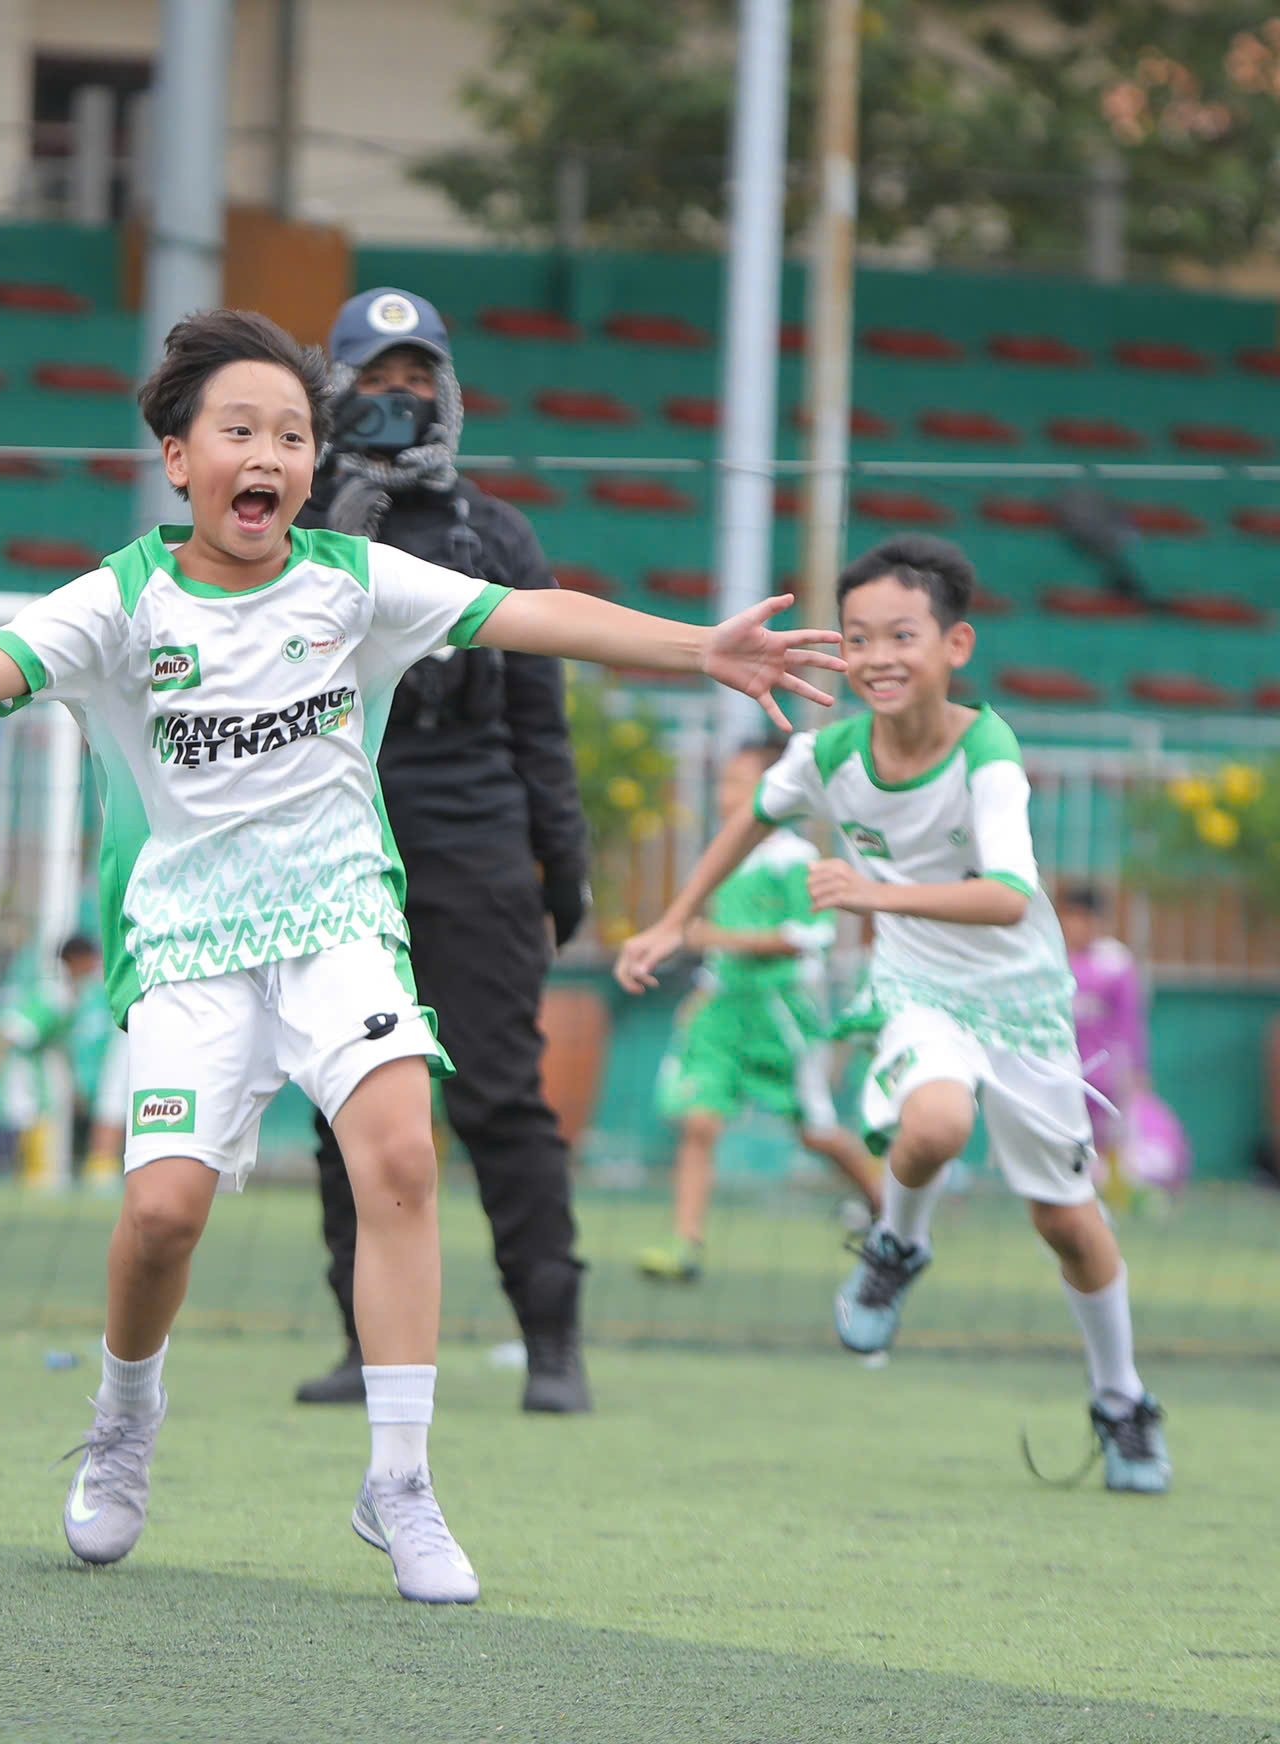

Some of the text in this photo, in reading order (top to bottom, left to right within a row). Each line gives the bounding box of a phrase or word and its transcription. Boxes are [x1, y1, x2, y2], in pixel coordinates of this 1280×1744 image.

[155, 661, 189, 676] MILO
[234, 716, 318, 758] NAM
[142, 1103, 183, 1117] MILO
